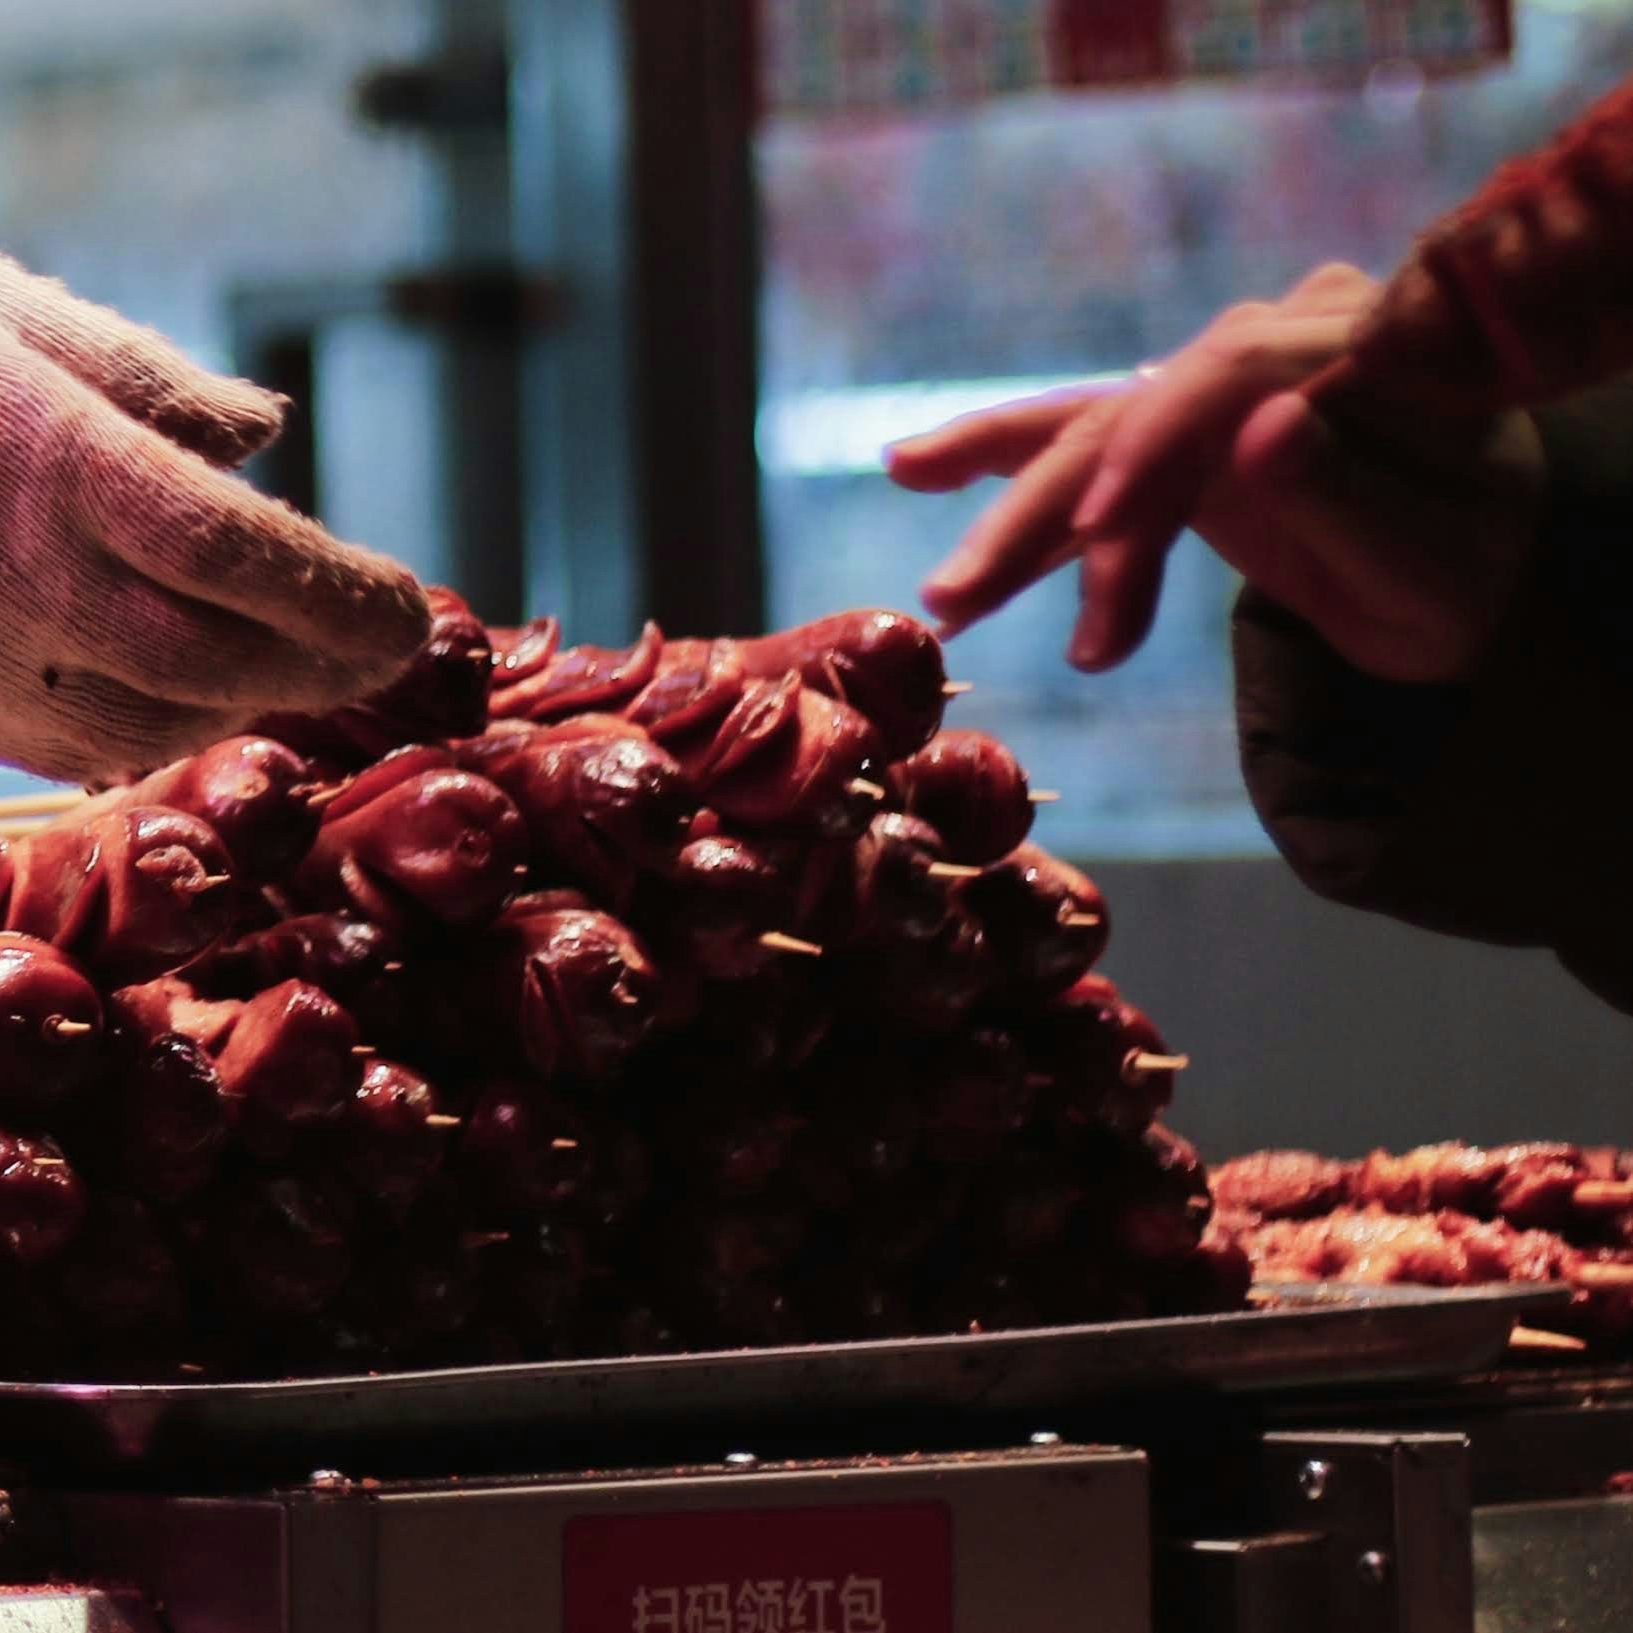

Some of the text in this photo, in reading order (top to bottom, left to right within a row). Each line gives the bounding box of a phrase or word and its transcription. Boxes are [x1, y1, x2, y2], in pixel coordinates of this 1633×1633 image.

[631, 1573, 886, 1633] 扫码领红包
